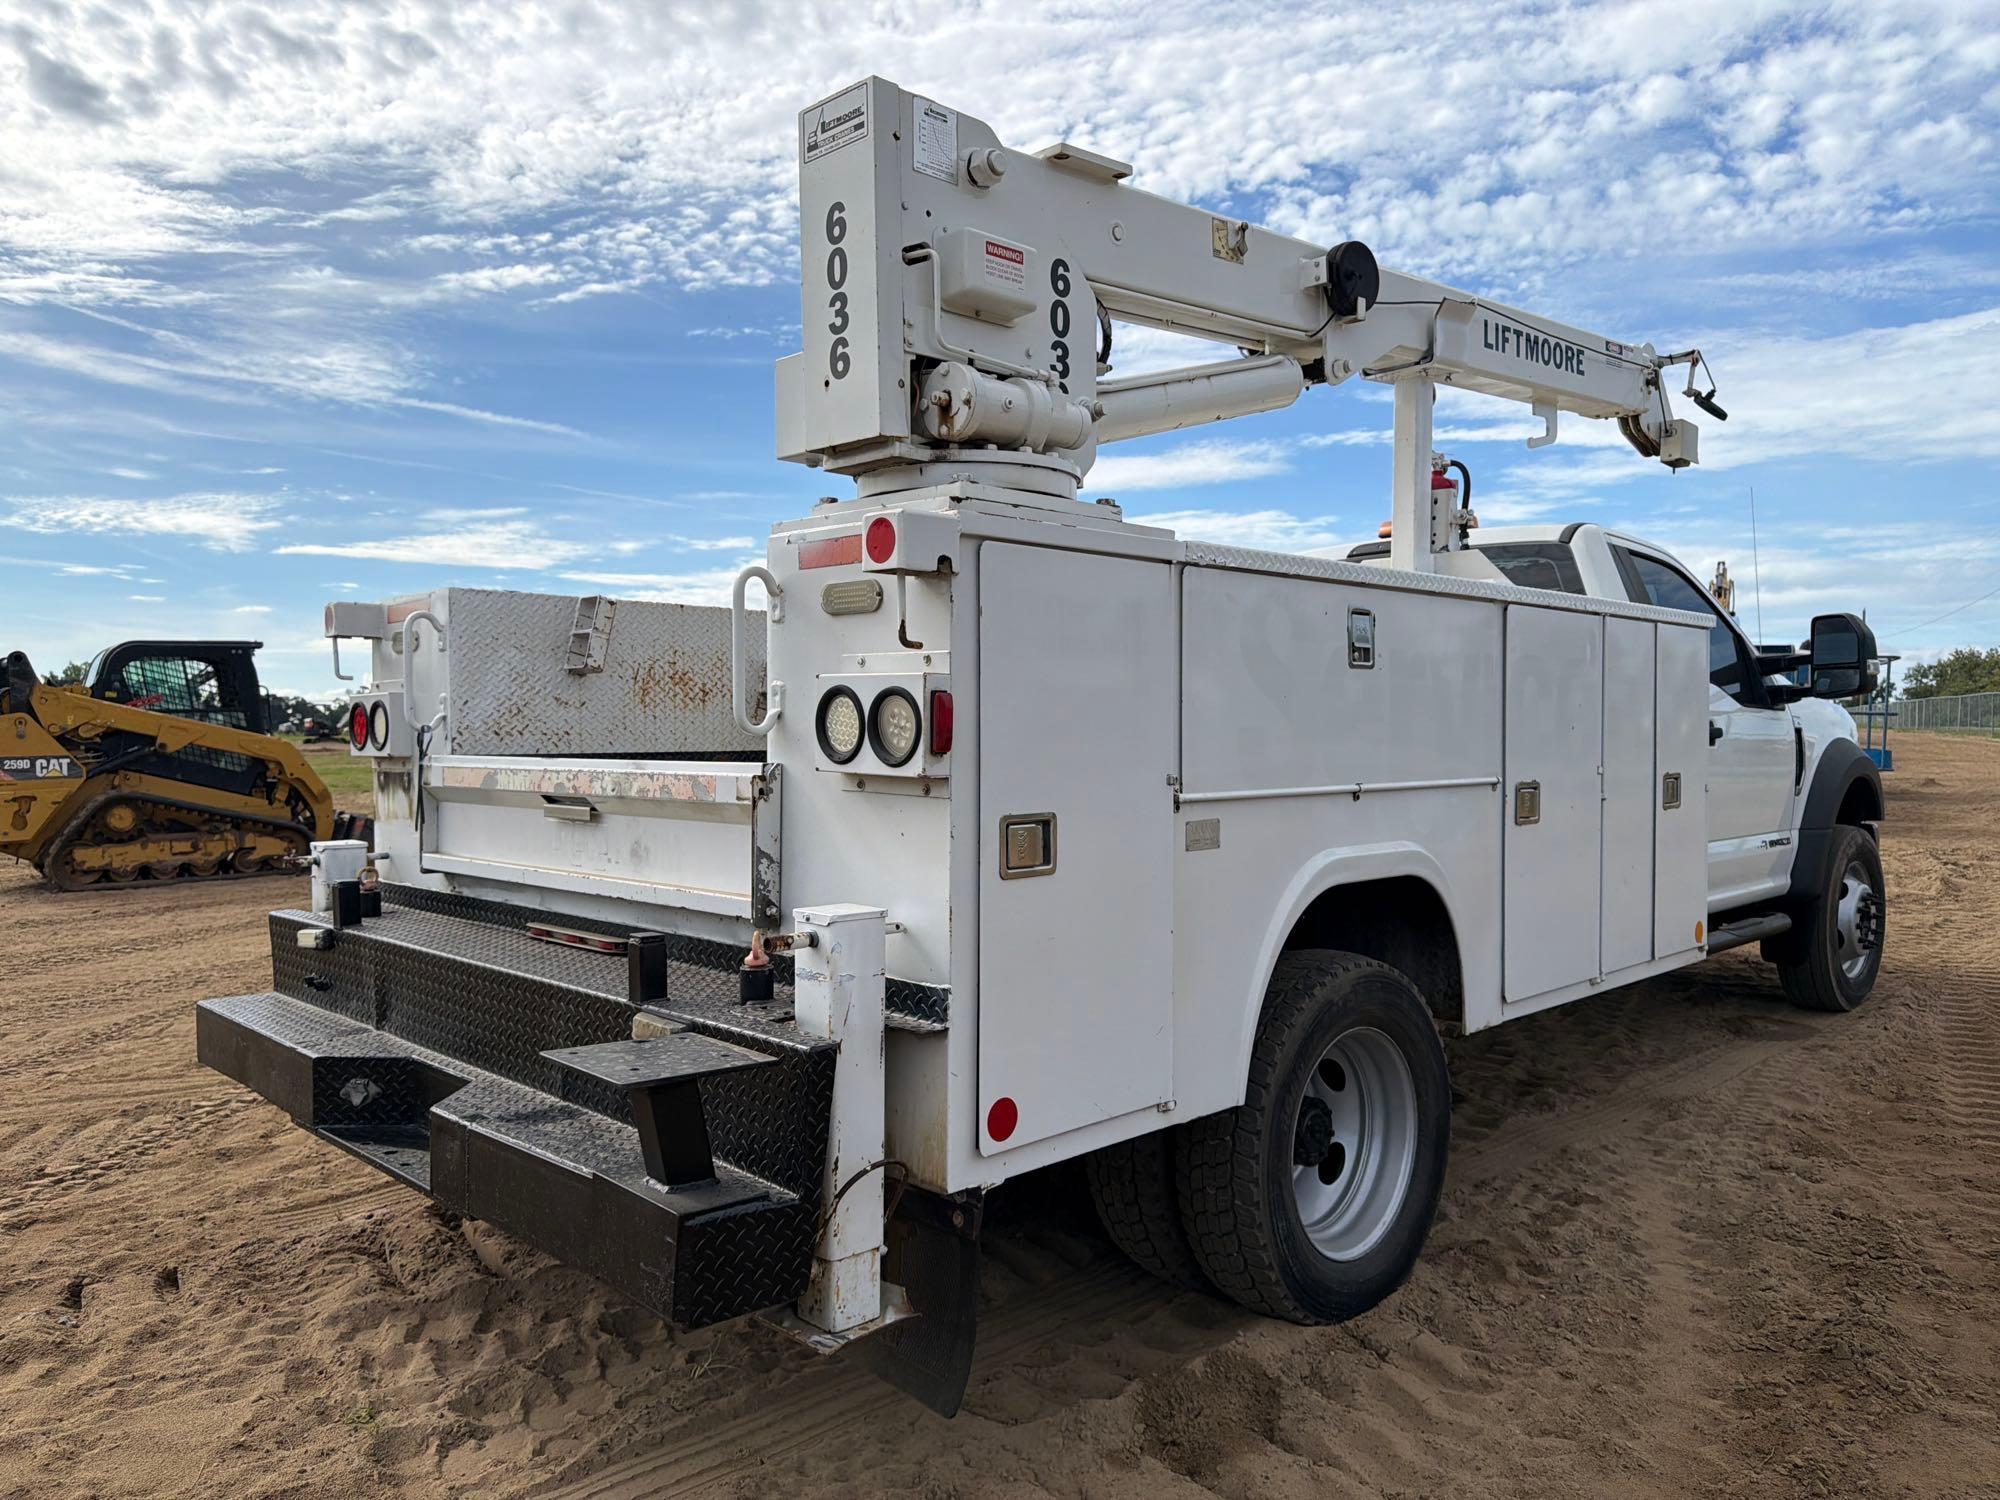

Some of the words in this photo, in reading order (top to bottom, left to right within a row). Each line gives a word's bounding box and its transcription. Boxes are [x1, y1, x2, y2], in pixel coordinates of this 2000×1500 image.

[821, 105, 863, 134] LIFTMOORE
[987, 242, 1023, 263] WARNING!
[826, 201, 851, 380] 6036
[1050, 258, 1071, 395] 603
[1484, 319, 1585, 377] LIFTMOORE
[3, 759, 31, 770] 259D
[35, 758, 70, 778] CAT
